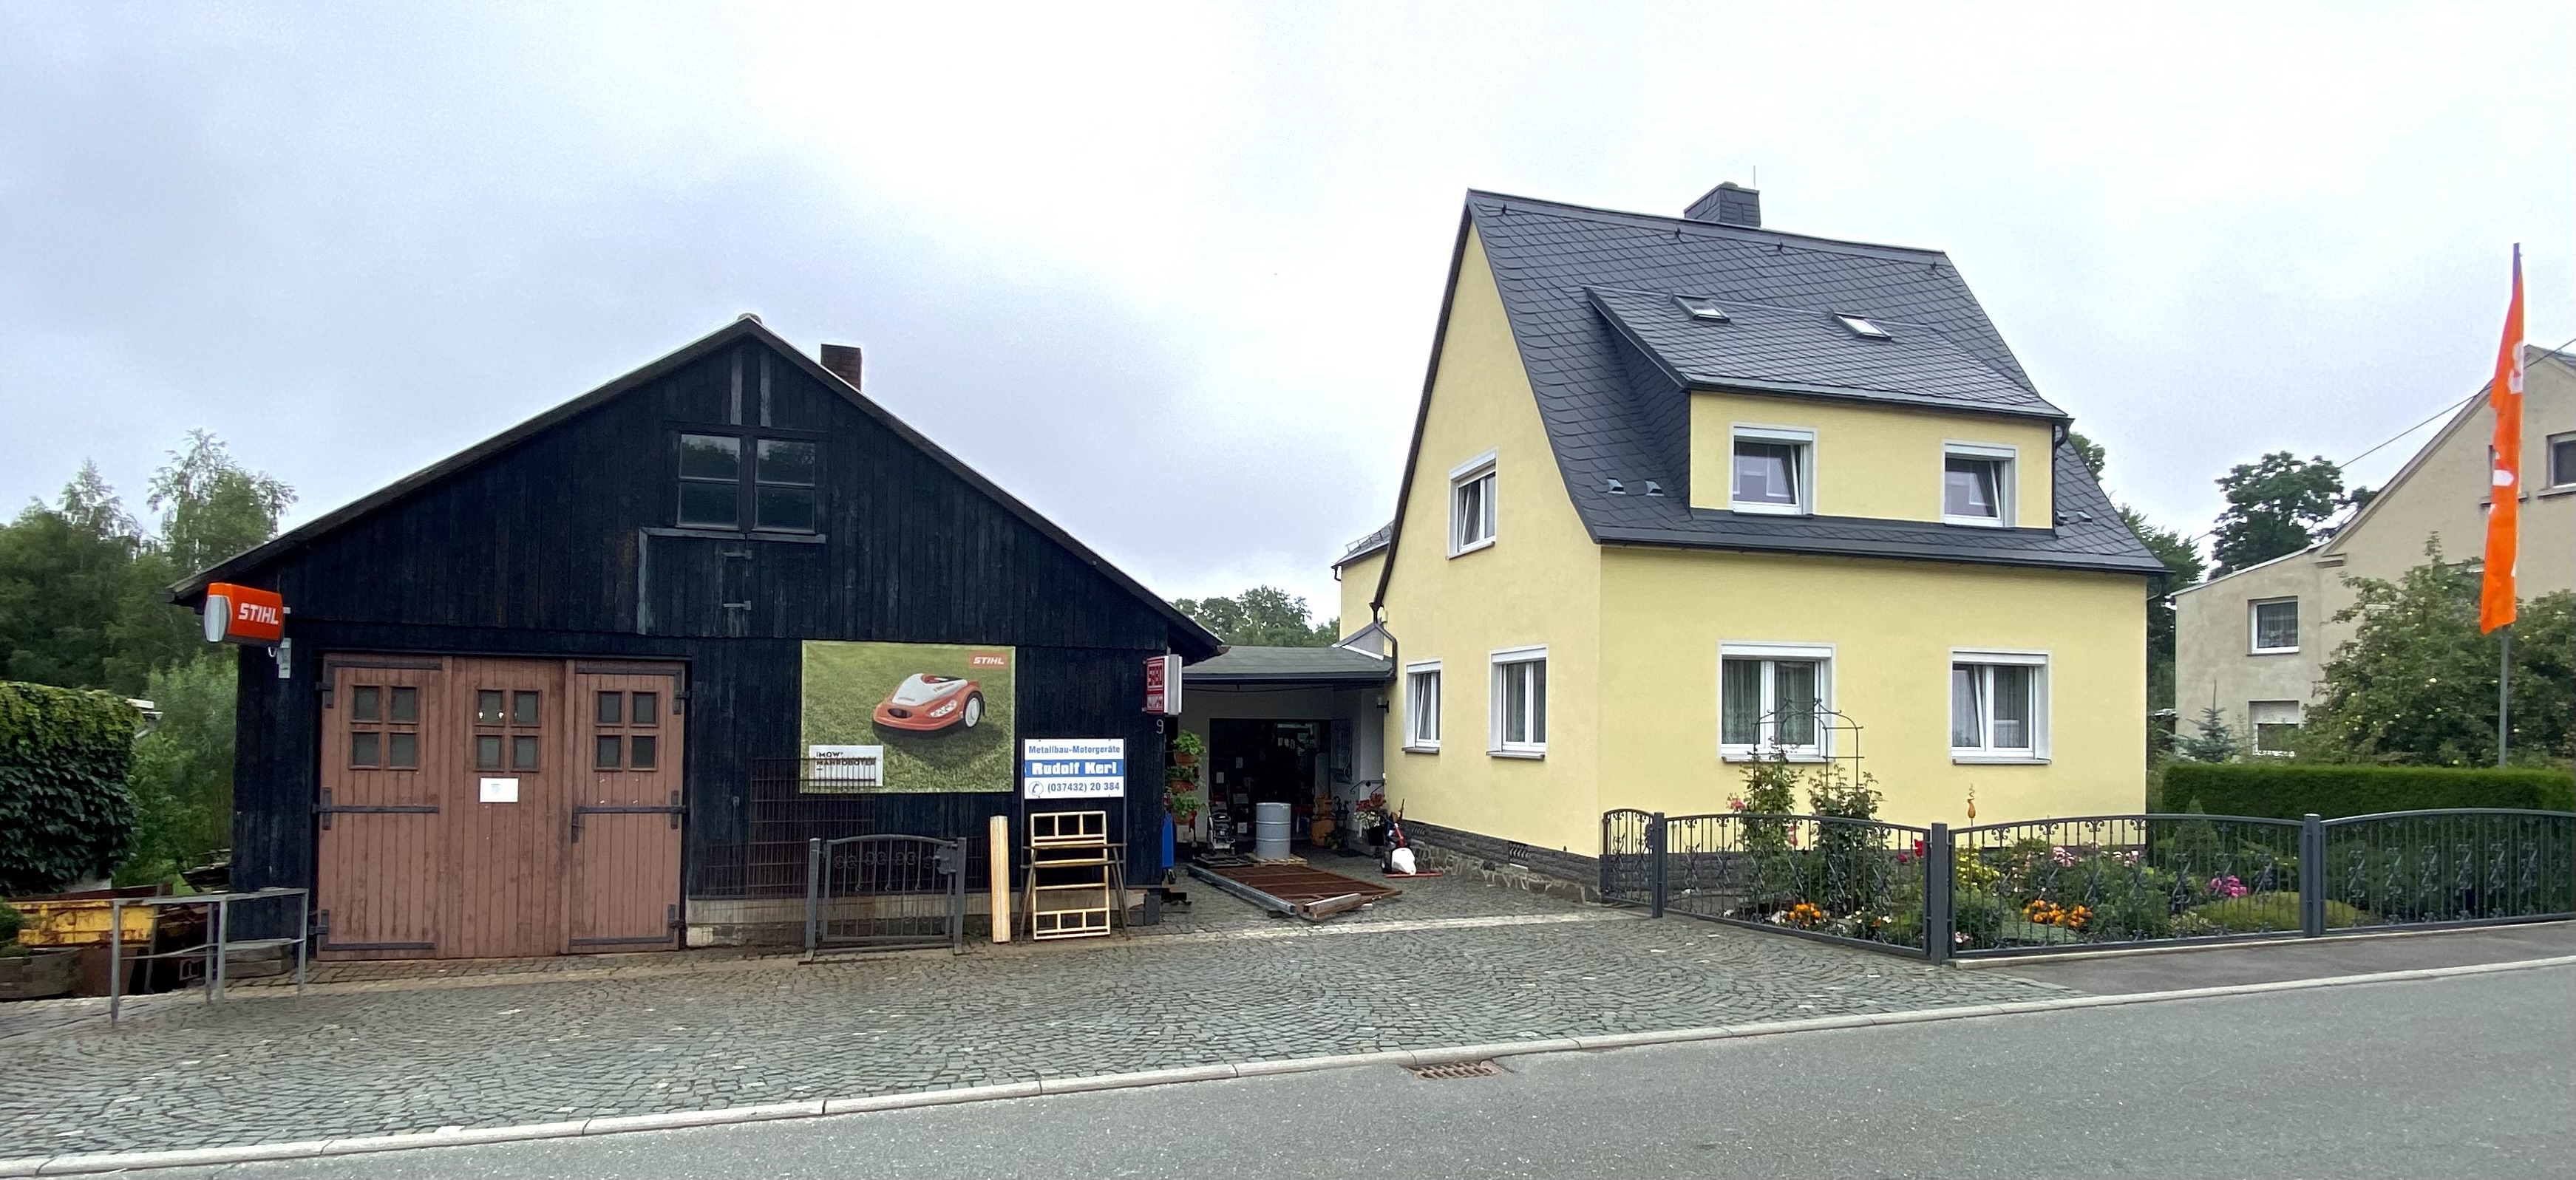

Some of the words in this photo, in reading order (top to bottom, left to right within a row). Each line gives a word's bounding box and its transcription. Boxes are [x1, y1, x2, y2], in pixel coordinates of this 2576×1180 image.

[237, 602, 279, 625] STIHL
[973, 656, 1005, 665] STIHL
[1156, 719, 1164, 734] 9
[1028, 746, 1121, 754] Metallbau-Motorgeräte
[1032, 762, 1080, 775] Rudolf
[1084, 761, 1117, 774] Kerl
[1047, 783, 1087, 793] (037432)
[1104, 782, 1120, 791] 384
